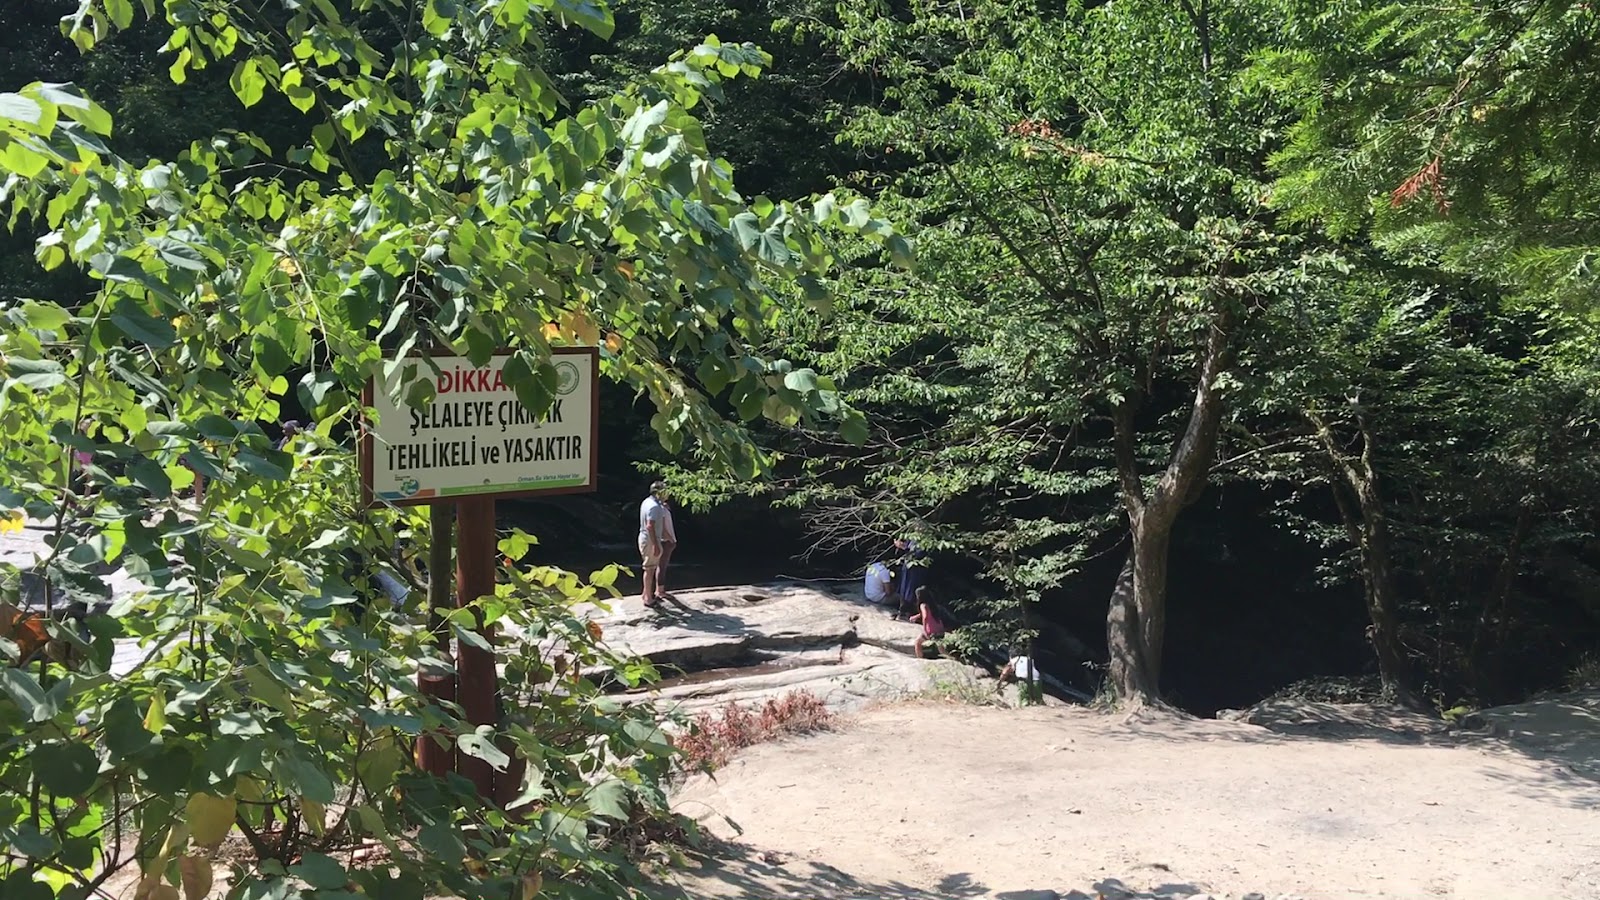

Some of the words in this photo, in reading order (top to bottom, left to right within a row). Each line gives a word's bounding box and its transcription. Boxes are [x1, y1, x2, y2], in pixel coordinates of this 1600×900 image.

[437, 365, 515, 394] DİKKA
[409, 401, 494, 437] ŞELALEYE
[497, 398, 564, 433] ÇIKK
[386, 434, 477, 471] TEHLİKELİ
[480, 445, 500, 465] ve
[503, 434, 583, 464] YASAKTIR
